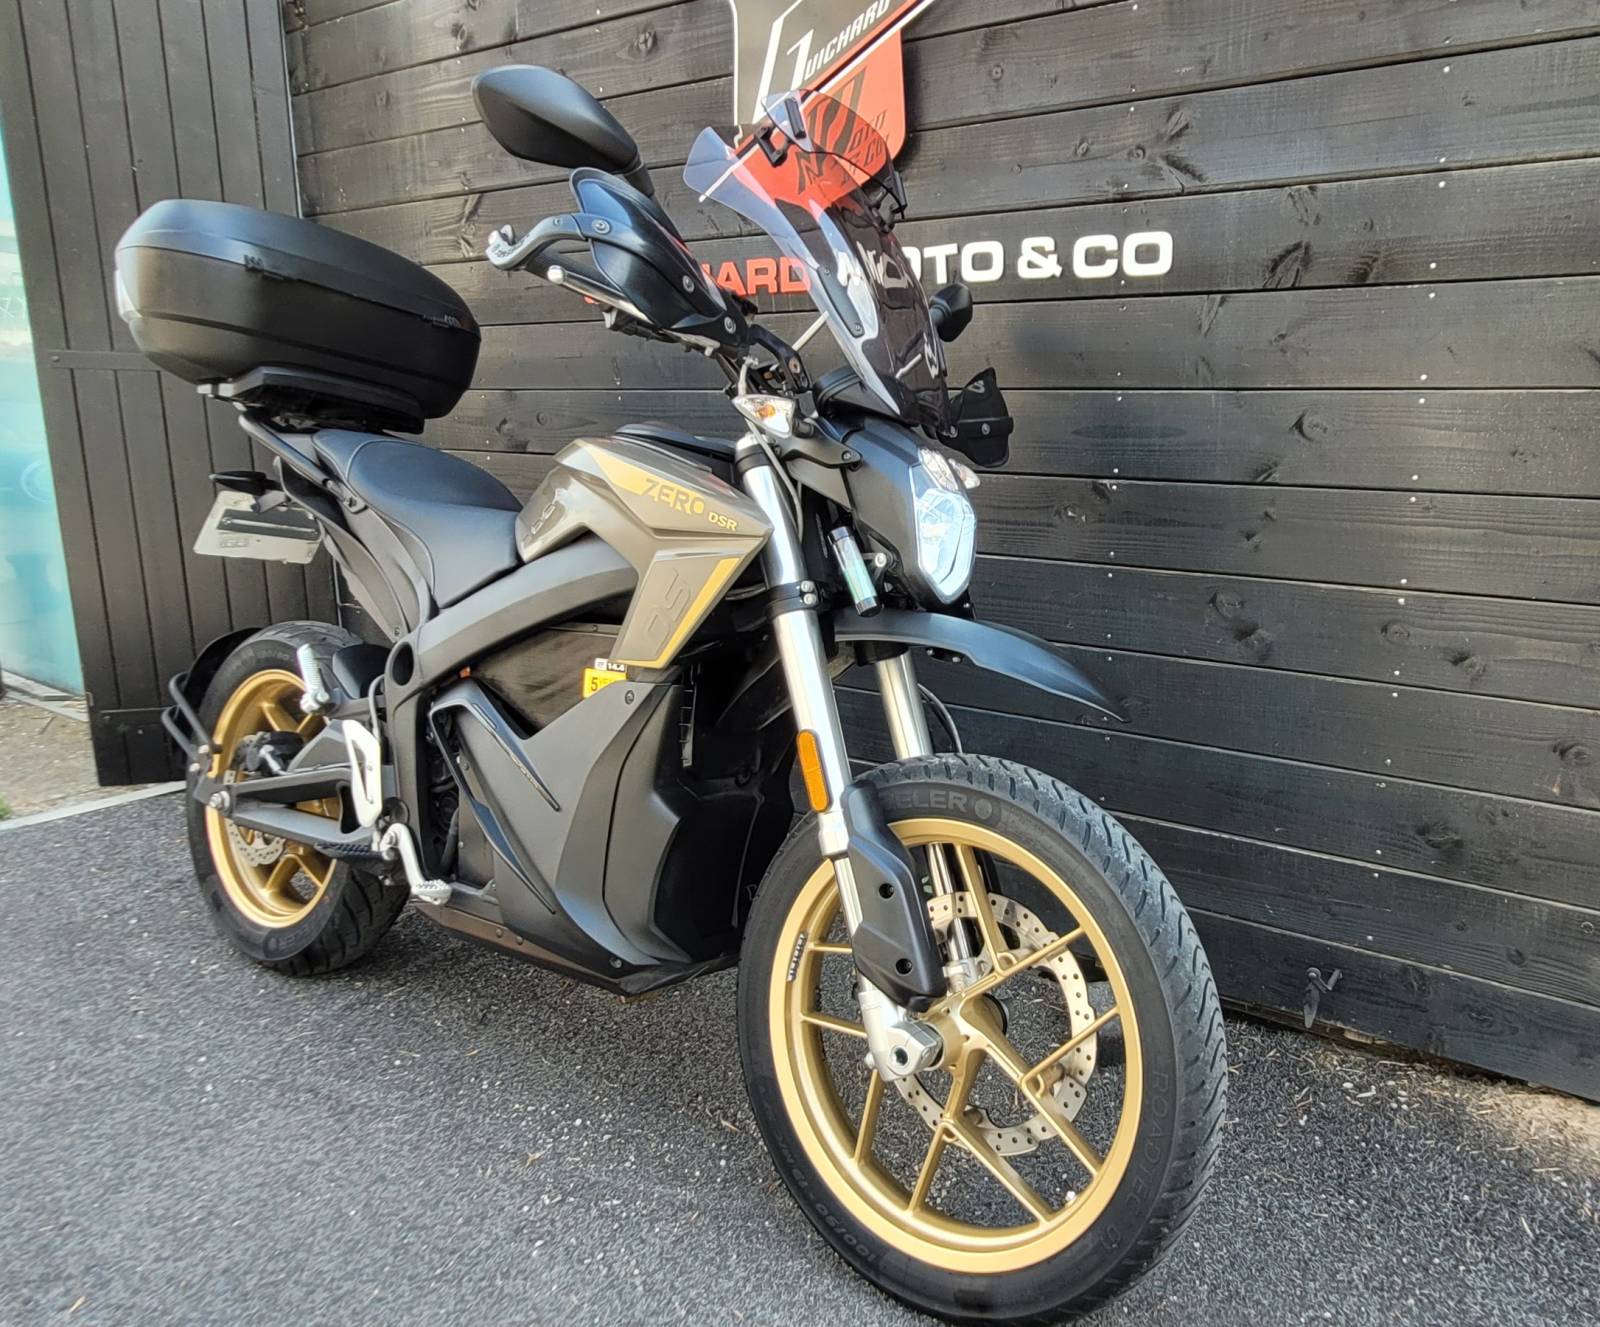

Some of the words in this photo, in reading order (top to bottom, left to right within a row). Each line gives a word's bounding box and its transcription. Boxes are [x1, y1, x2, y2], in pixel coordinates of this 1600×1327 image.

[1017, 236, 1063, 279] &
[1073, 231, 1174, 279] CO
[641, 478, 706, 516] ZERO
[708, 511, 738, 532] DSR
[1126, 1072, 1169, 1213] ROADTEC
